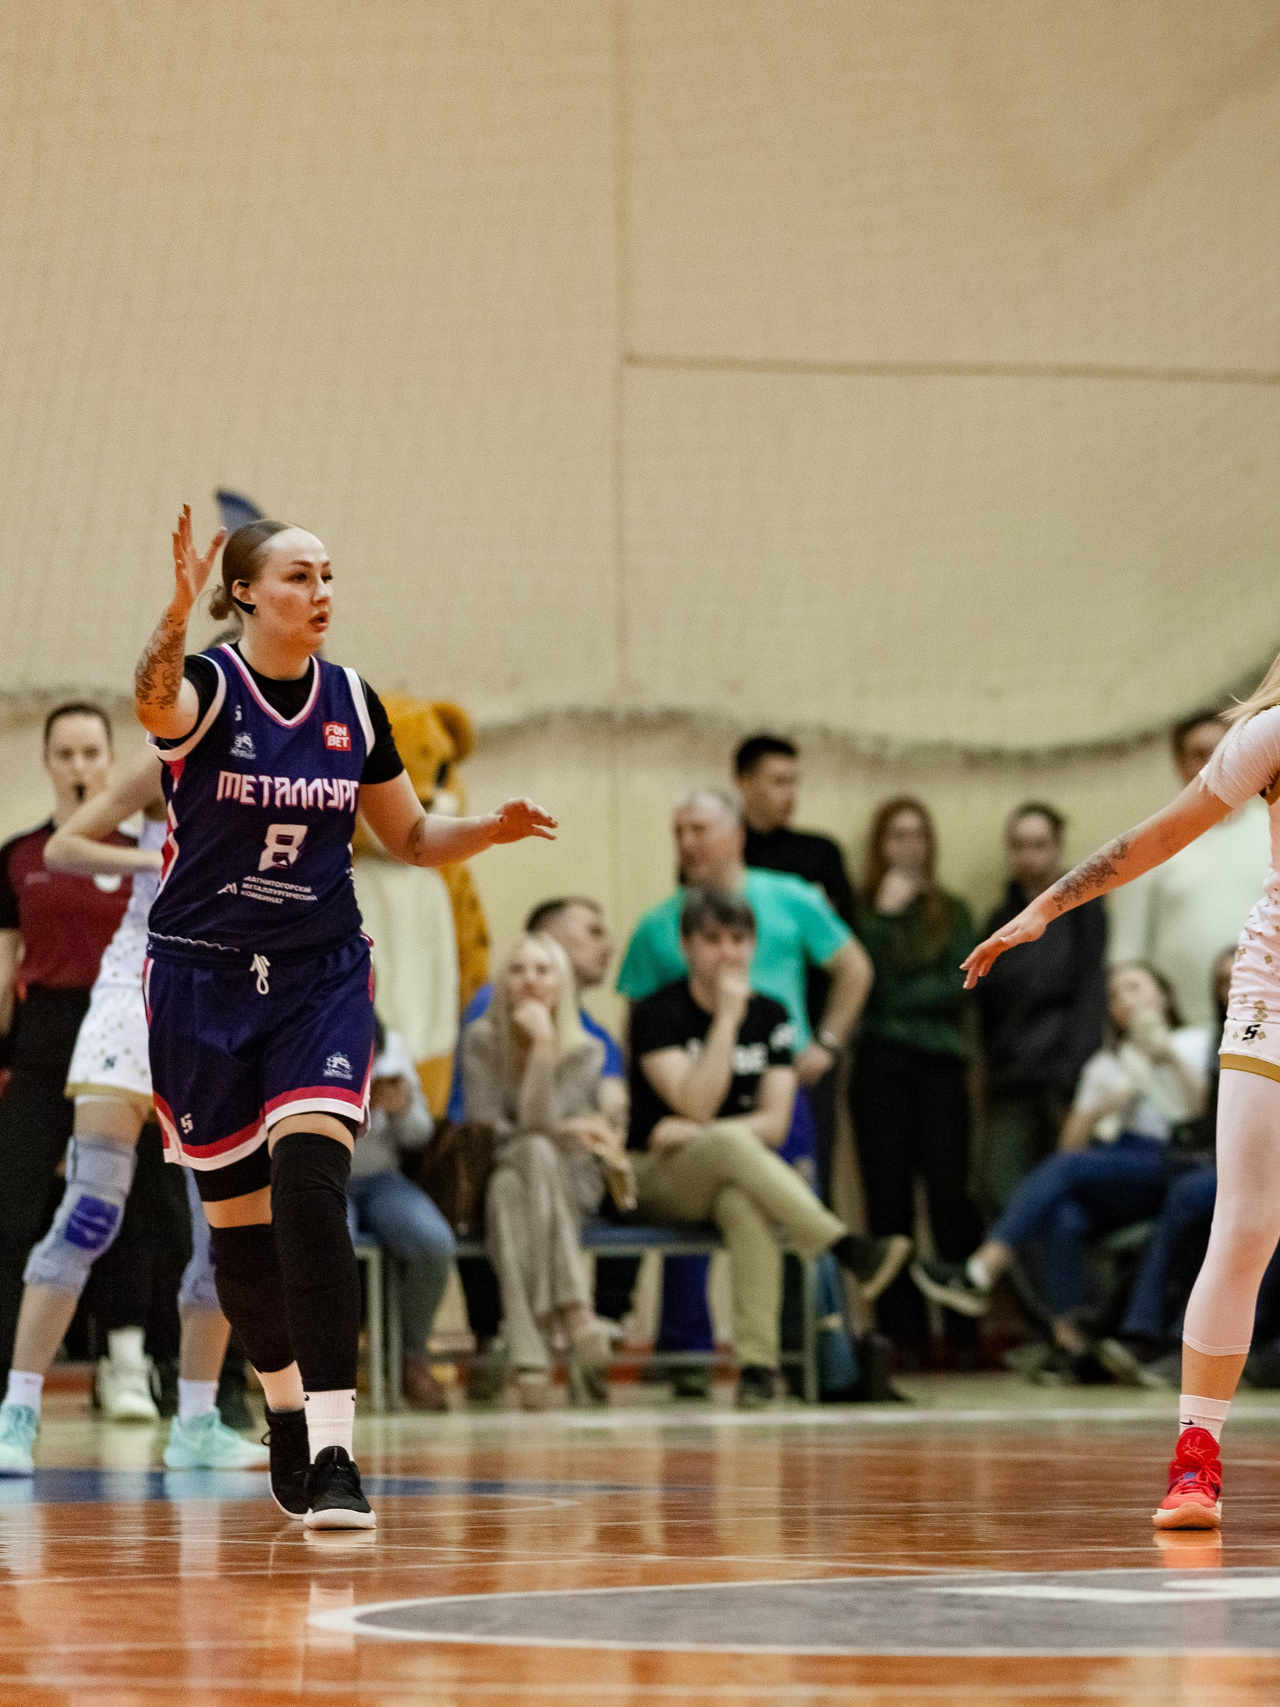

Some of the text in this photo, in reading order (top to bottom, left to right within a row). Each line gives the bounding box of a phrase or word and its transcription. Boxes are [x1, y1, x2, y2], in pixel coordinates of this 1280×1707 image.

[327, 735, 350, 749] BET
[216, 770, 360, 813] МЕТАЛЛУРГ
[258, 823, 309, 872] 8
